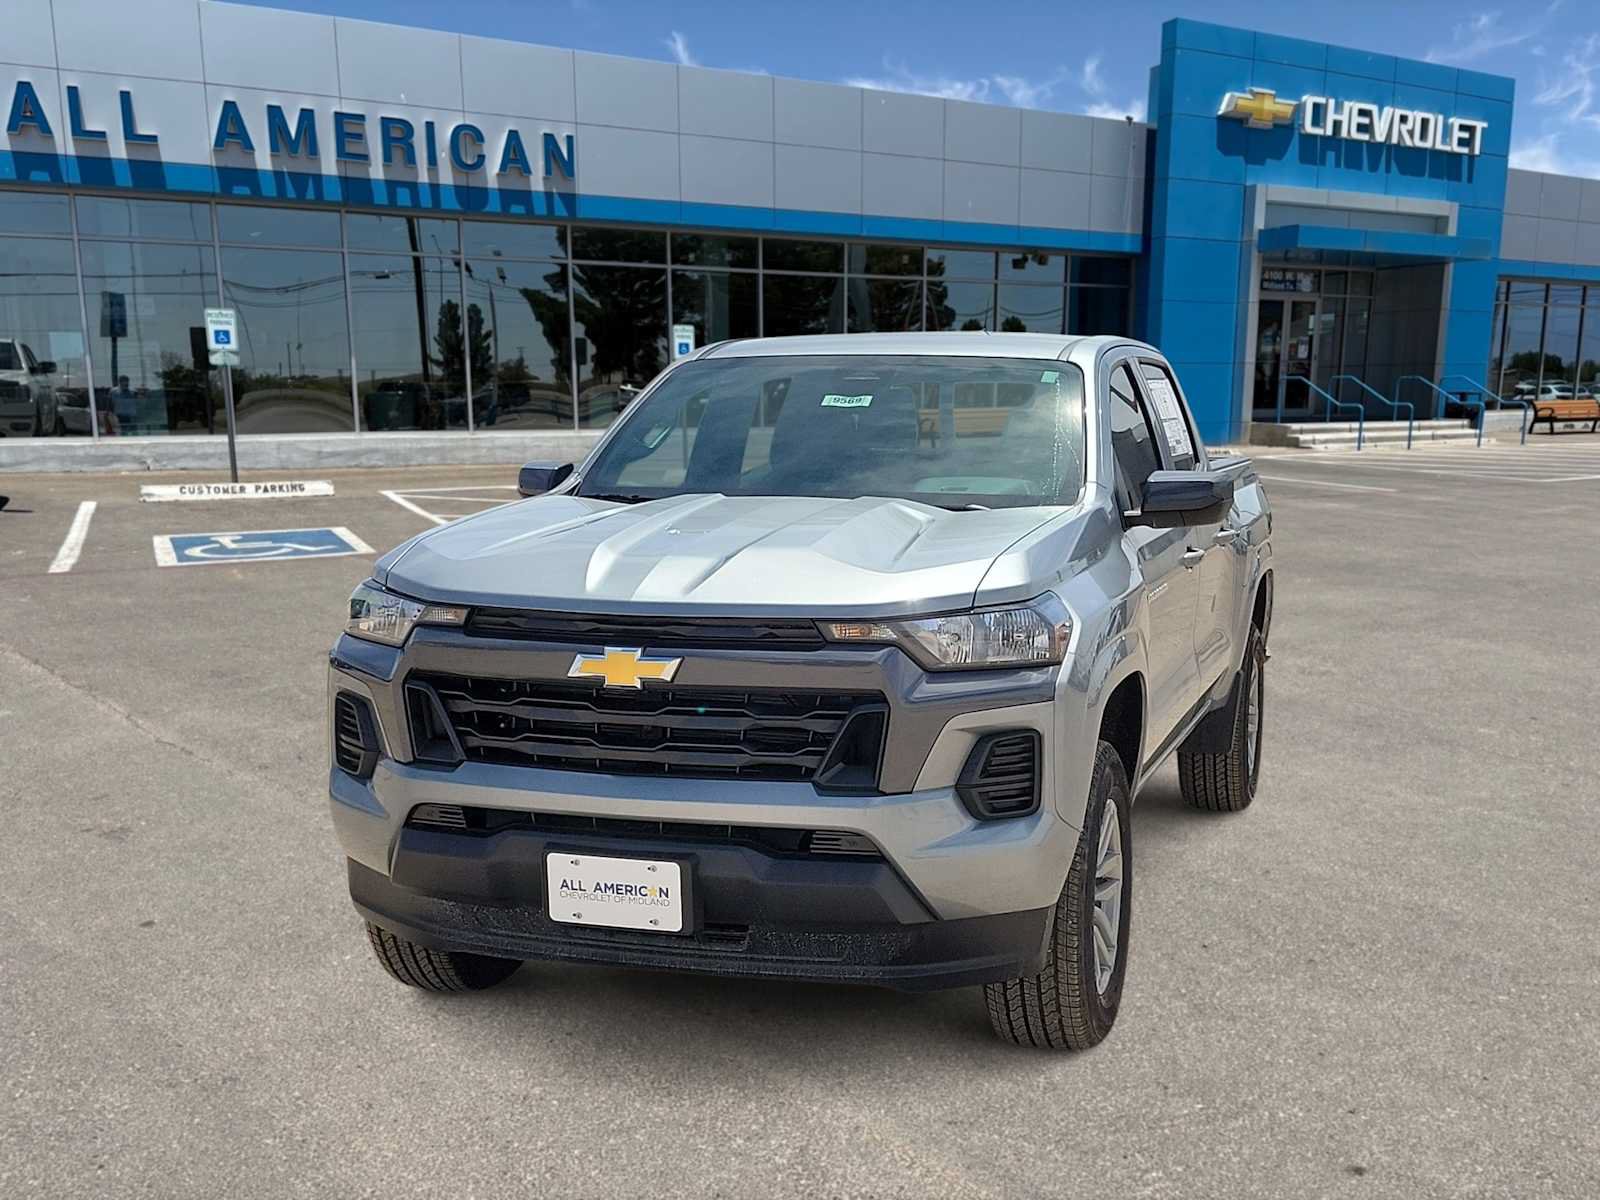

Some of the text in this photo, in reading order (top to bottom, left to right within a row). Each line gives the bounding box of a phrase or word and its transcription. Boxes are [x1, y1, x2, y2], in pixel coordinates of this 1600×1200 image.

[6, 81, 575, 179] ALL AMERICAN
[1301, 94, 1489, 156] CHEVROLET
[179, 483, 306, 495] CUSTOMER PARKING
[560, 879, 587, 892] ALL
[560, 890, 671, 907] CHEVROLET OF MIDLAND
